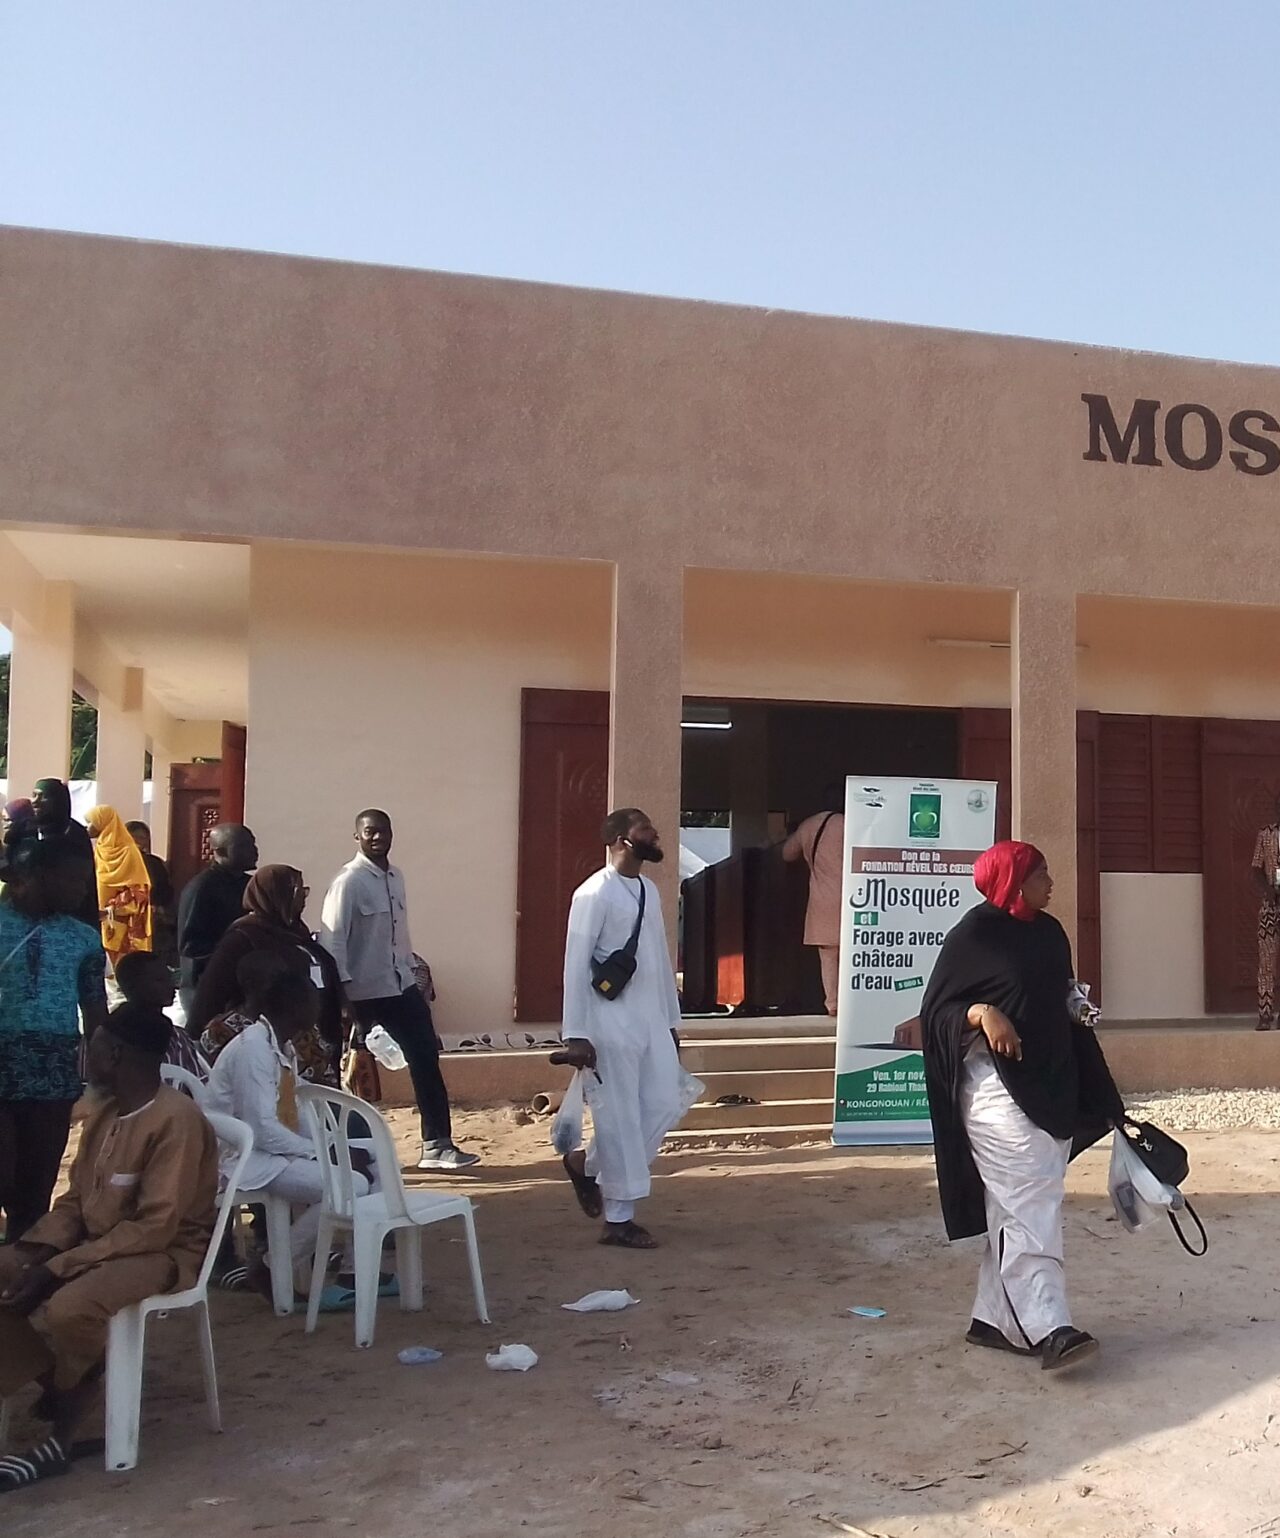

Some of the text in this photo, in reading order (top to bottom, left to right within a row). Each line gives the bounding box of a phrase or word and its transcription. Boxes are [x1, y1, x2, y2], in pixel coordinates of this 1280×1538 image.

[919, 852, 931, 861] de
[861, 861, 904, 872] FONDATION
[906, 860, 932, 873] RÉVEIL
[933, 863, 948, 873] DES
[849, 878, 960, 914] Mosquée
[860, 912, 872, 924] et
[853, 929, 944, 947] Forage avec
[852, 950, 913, 968] château
[851, 973, 893, 991] d'eau
[873, 1071, 891, 1080] Ven.
[894, 1070, 906, 1080] 1er
[846, 1100, 909, 1108] KONGONOUAN
